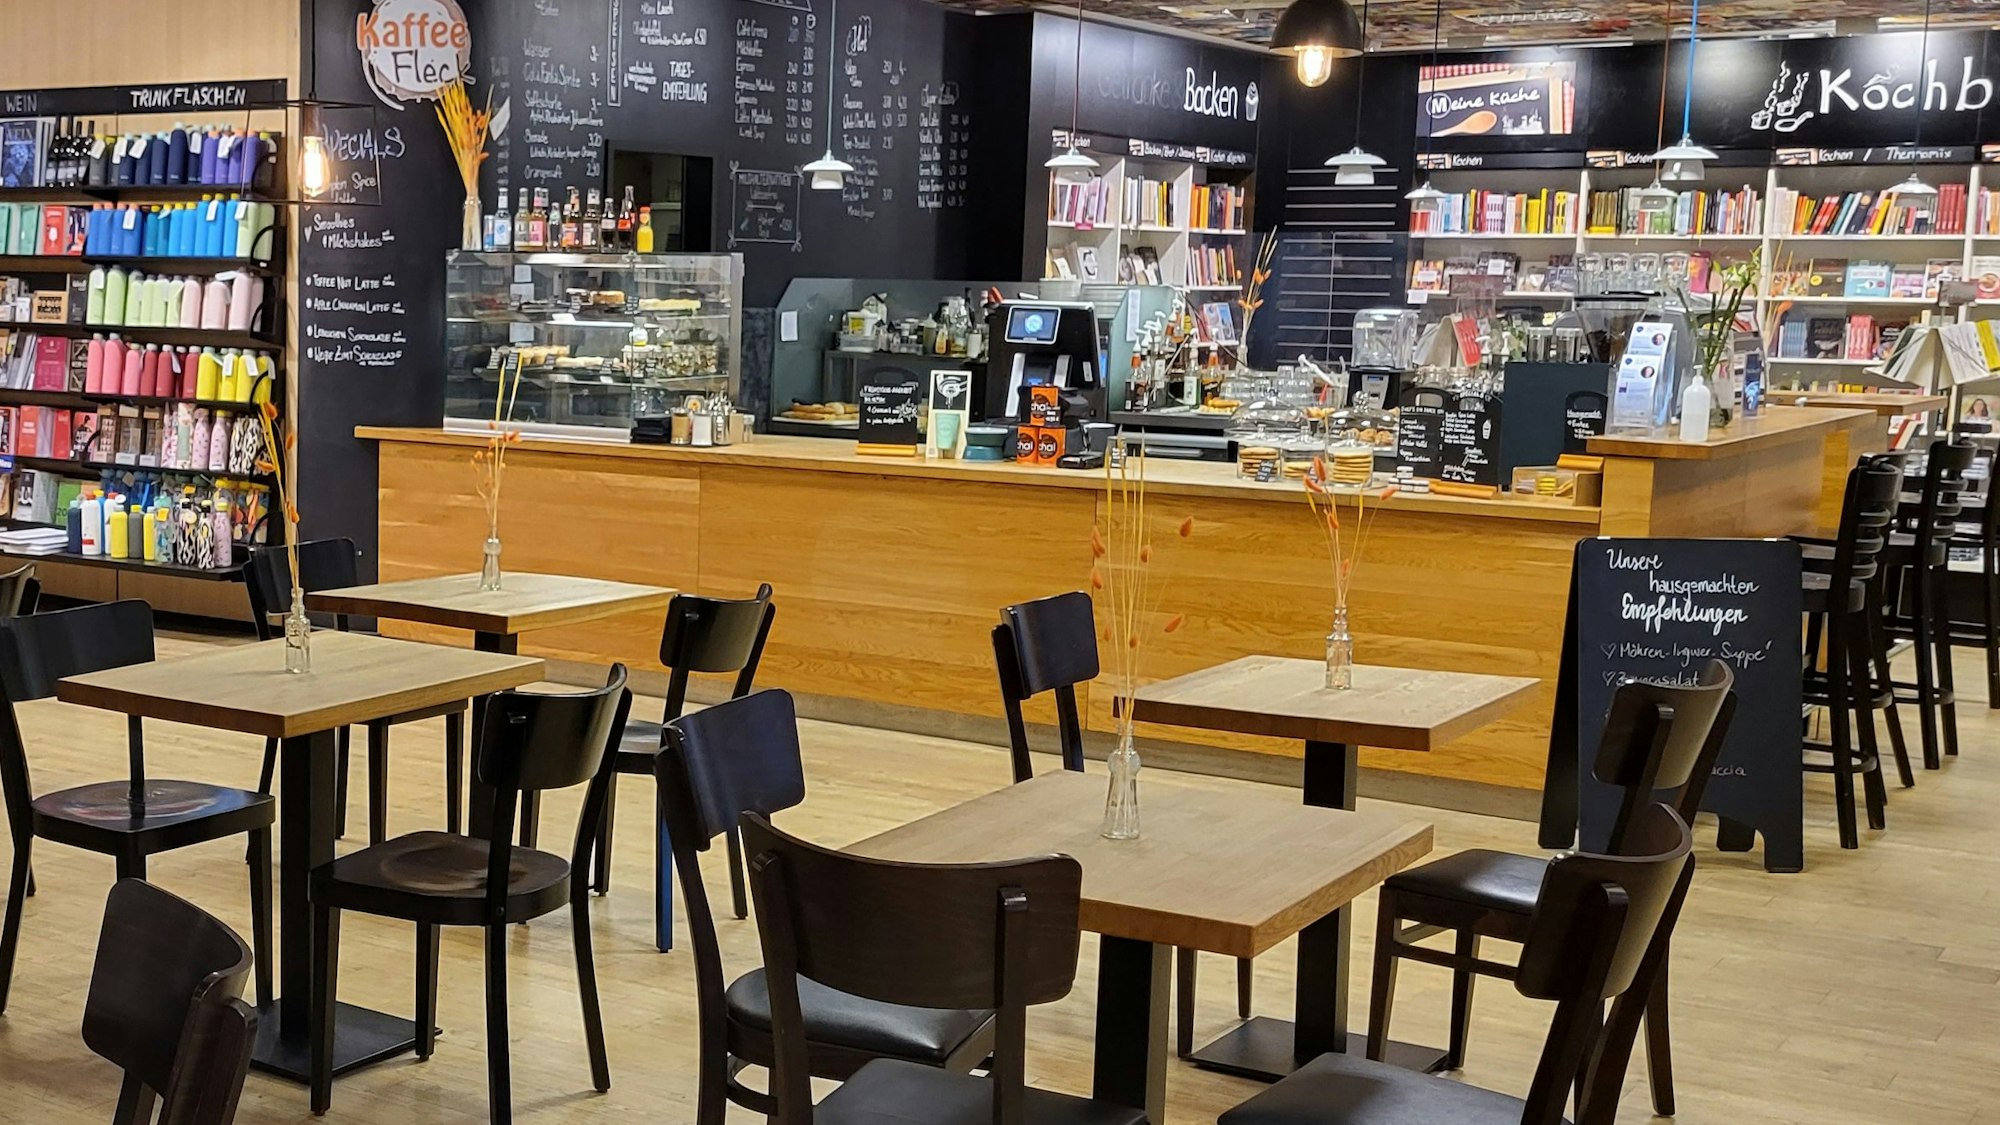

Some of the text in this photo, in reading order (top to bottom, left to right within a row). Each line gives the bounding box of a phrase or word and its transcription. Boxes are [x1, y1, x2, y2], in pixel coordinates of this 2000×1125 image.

[357, 11, 467, 50] Kaffee
[6, 95, 37, 113] WEIN
[1184, 66, 1238, 119] Backen
[1426, 87, 1541, 119] Meine Küche
[1452, 154, 1483, 167] Kochen
[1819, 148, 1853, 163] Kochen
[1606, 548, 1663, 571] Unsere
[1649, 571, 1759, 602] hausgemachten
[1622, 592, 1748, 636] Empfehlungen
